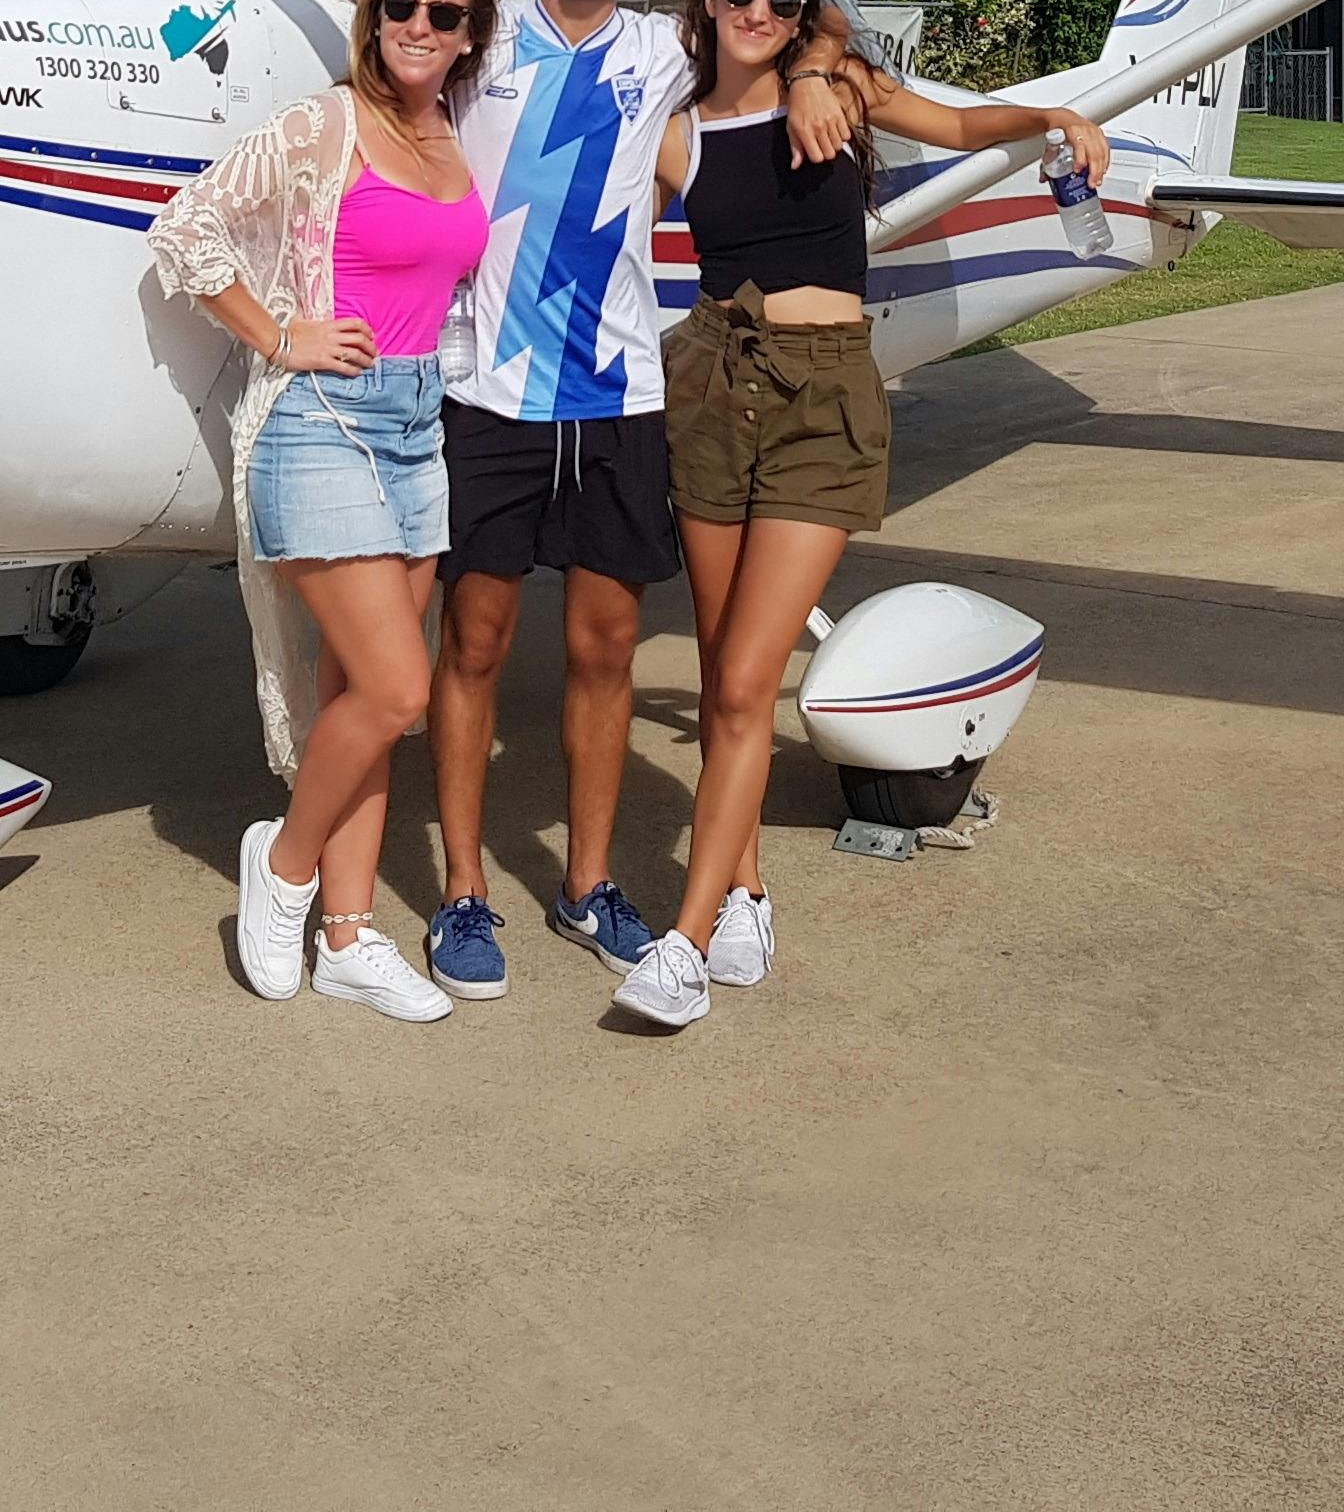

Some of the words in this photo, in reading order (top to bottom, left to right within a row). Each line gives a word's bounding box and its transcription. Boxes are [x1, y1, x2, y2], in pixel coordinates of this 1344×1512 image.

[35, 56, 81, 79] 1300
[86, 59, 122, 82] 320
[126, 62, 160, 85] 330
